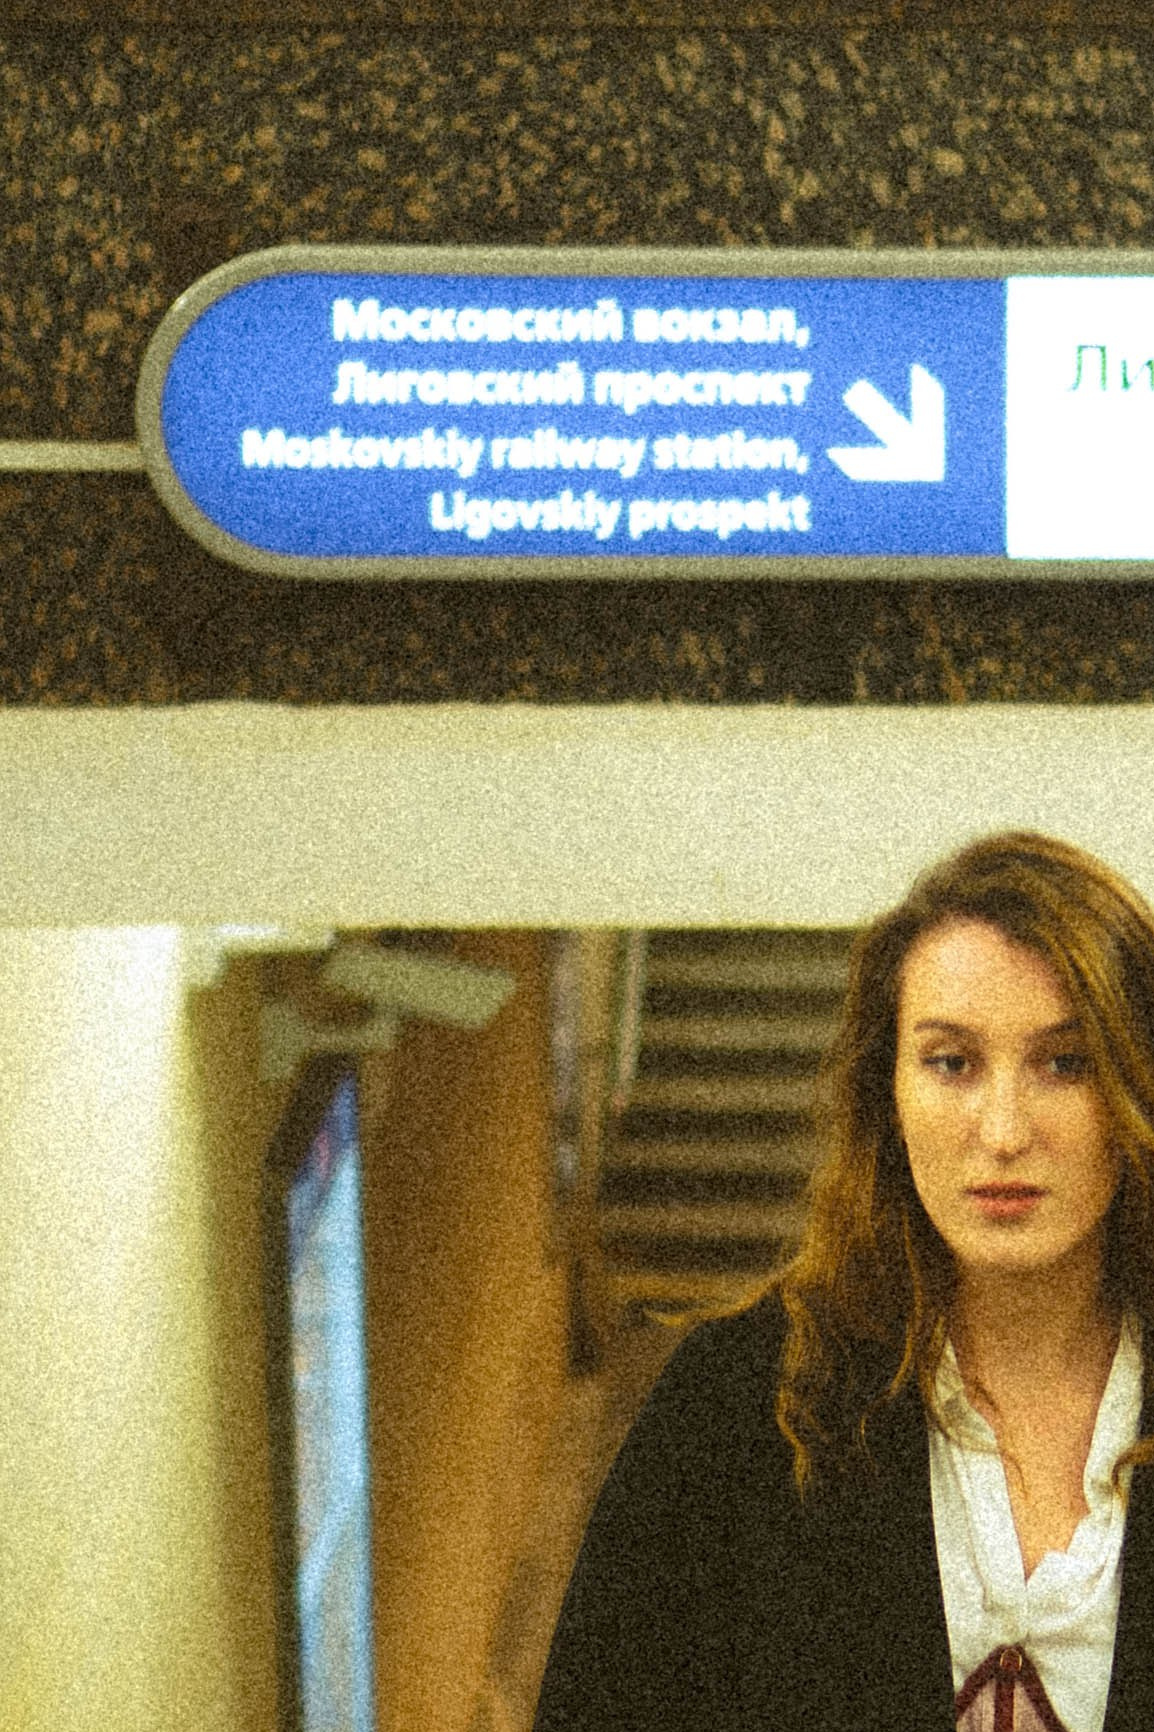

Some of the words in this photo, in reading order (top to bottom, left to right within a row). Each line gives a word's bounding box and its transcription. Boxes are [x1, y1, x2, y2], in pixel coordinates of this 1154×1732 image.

[331, 298, 623, 342] Московский
[633, 304, 810, 347] вокзал,
[331, 361, 584, 406] Лиговский
[595, 368, 812, 414] проспект
[242, 429, 484, 478] Moskovskiy
[491, 429, 646, 478] railway
[654, 430, 809, 475] station,
[429, 491, 621, 540] Ligovskiy
[629, 492, 812, 540] prospekt
